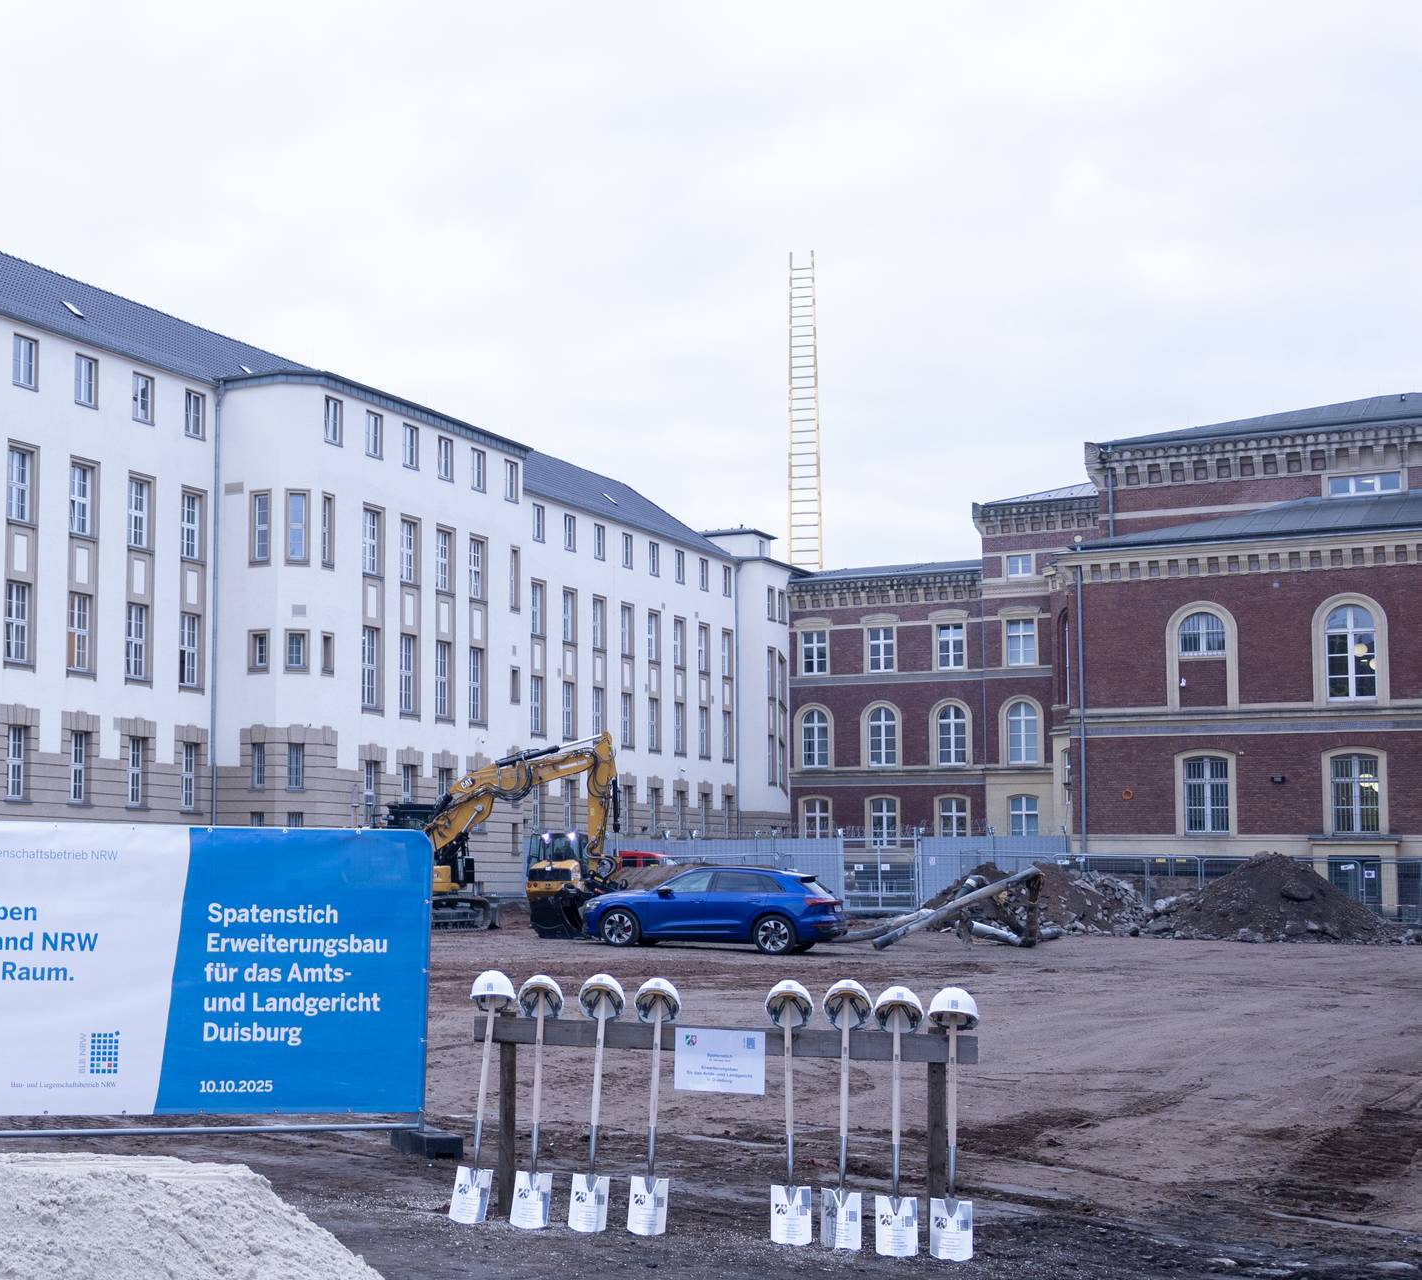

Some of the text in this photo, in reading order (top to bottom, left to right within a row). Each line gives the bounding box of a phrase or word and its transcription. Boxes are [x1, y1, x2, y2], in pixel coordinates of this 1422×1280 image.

[461, 778, 473, 789] CAT
[91, 849, 118, 861] NRW
[208, 903, 338, 927] Spatenstich
[42, 932, 99, 952] NRW
[206, 933, 388, 957] Erweiterungsbau
[1, 961, 74, 982] Raum.
[204, 962, 352, 983] für das Amts-
[203, 992, 381, 1017] und Landgericht
[202, 1022, 302, 1046] Duisburg
[199, 1080, 273, 1093] 10.10.2025
